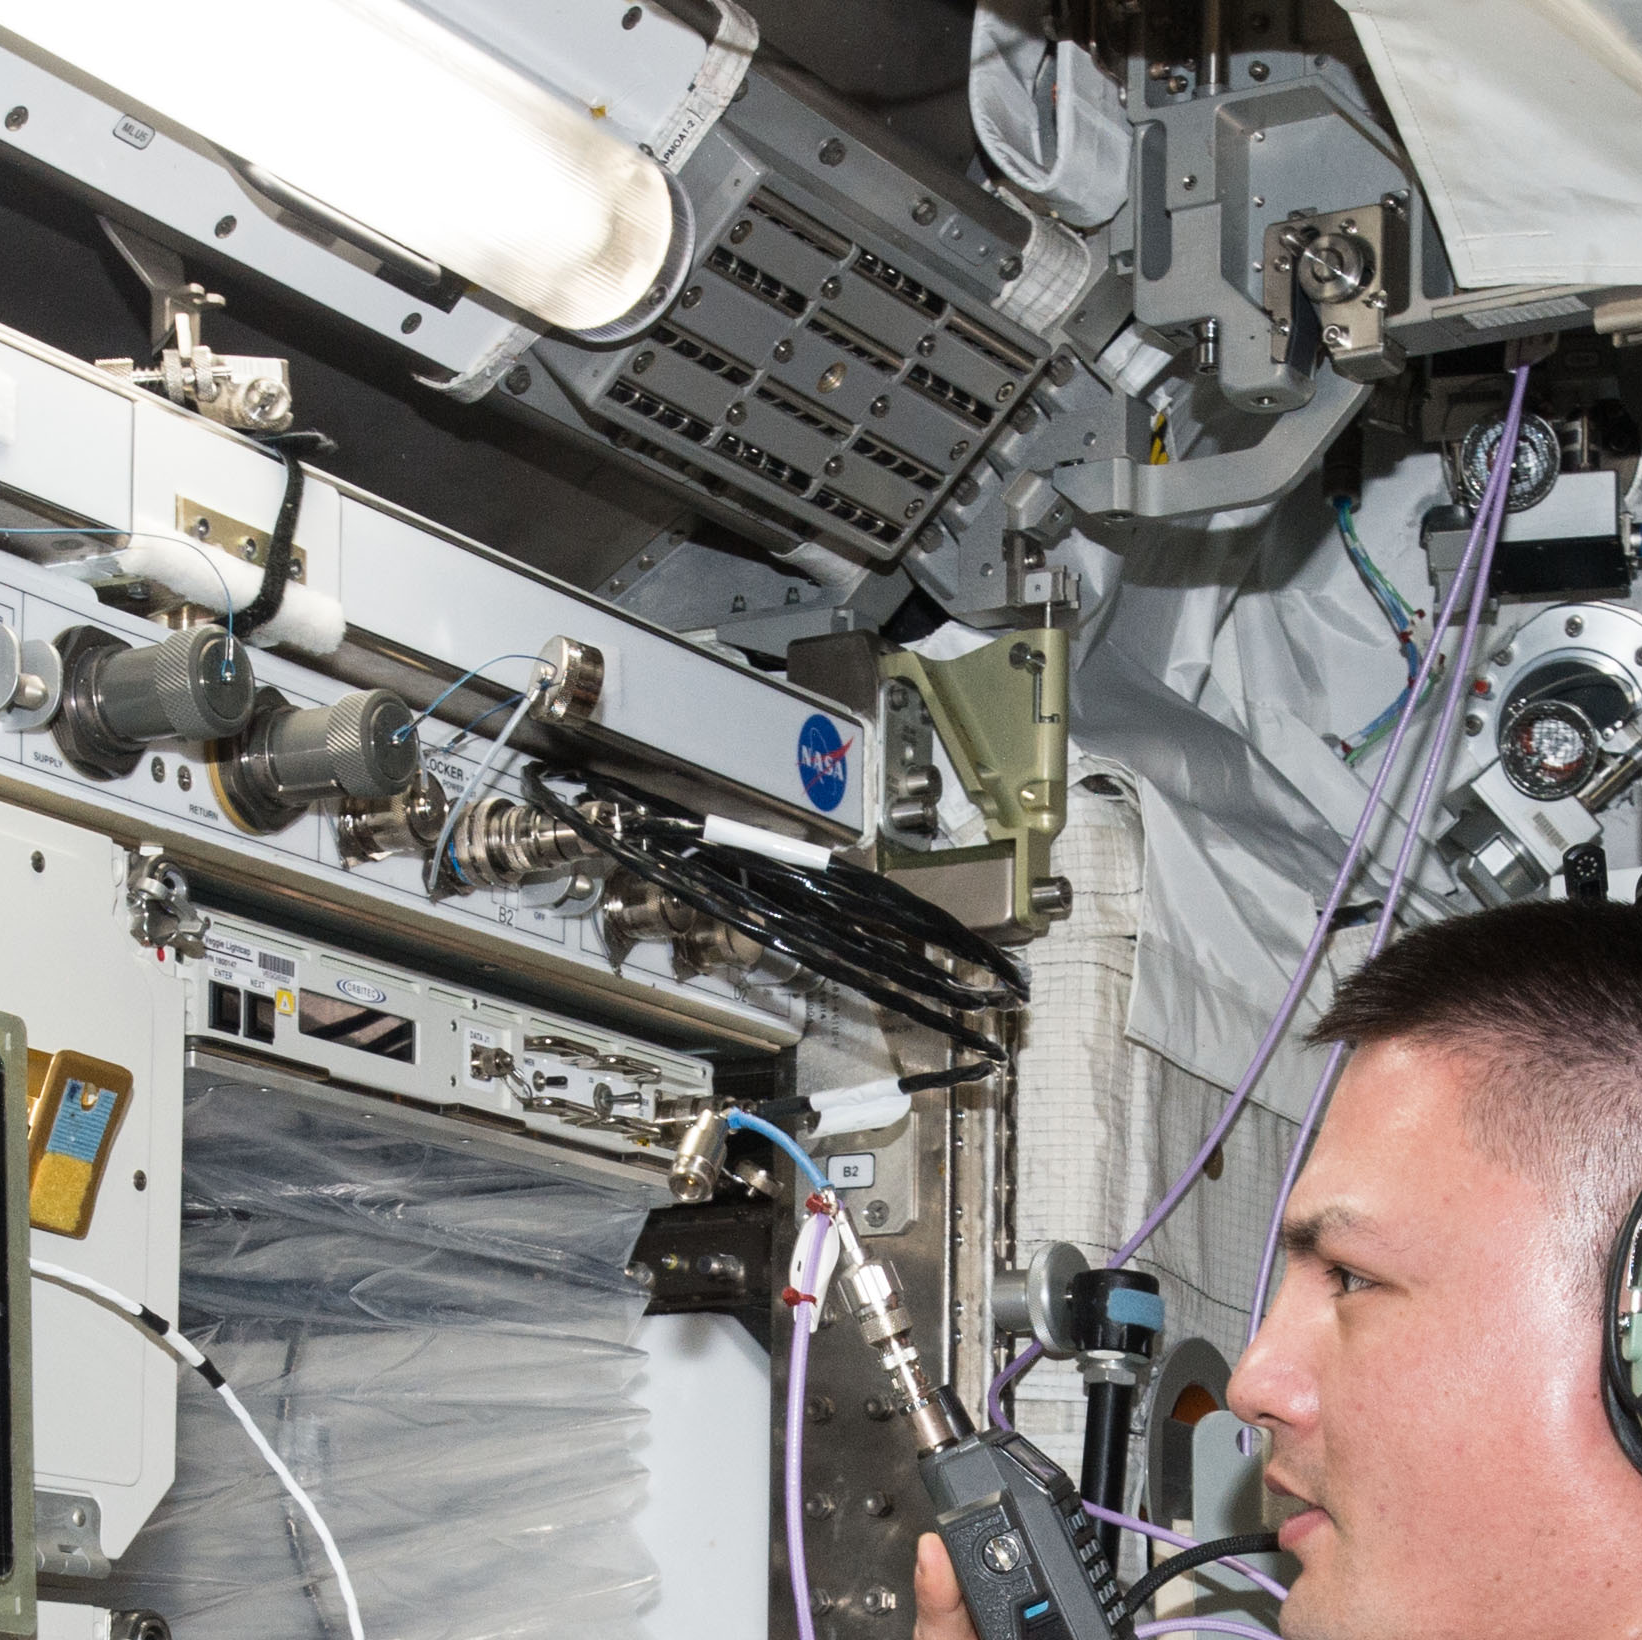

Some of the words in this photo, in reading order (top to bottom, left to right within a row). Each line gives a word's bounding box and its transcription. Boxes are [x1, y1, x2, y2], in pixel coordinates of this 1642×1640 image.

[33, 751, 63, 768] SUPPLY
[801, 743, 844, 782] NASA
[423, 756, 465, 782] LOCKER
[188, 804, 219, 822] RETURN
[498, 905, 514, 927] B2
[346, 982, 377, 999] ORBITEC
[842, 1165, 859, 1179] B2
